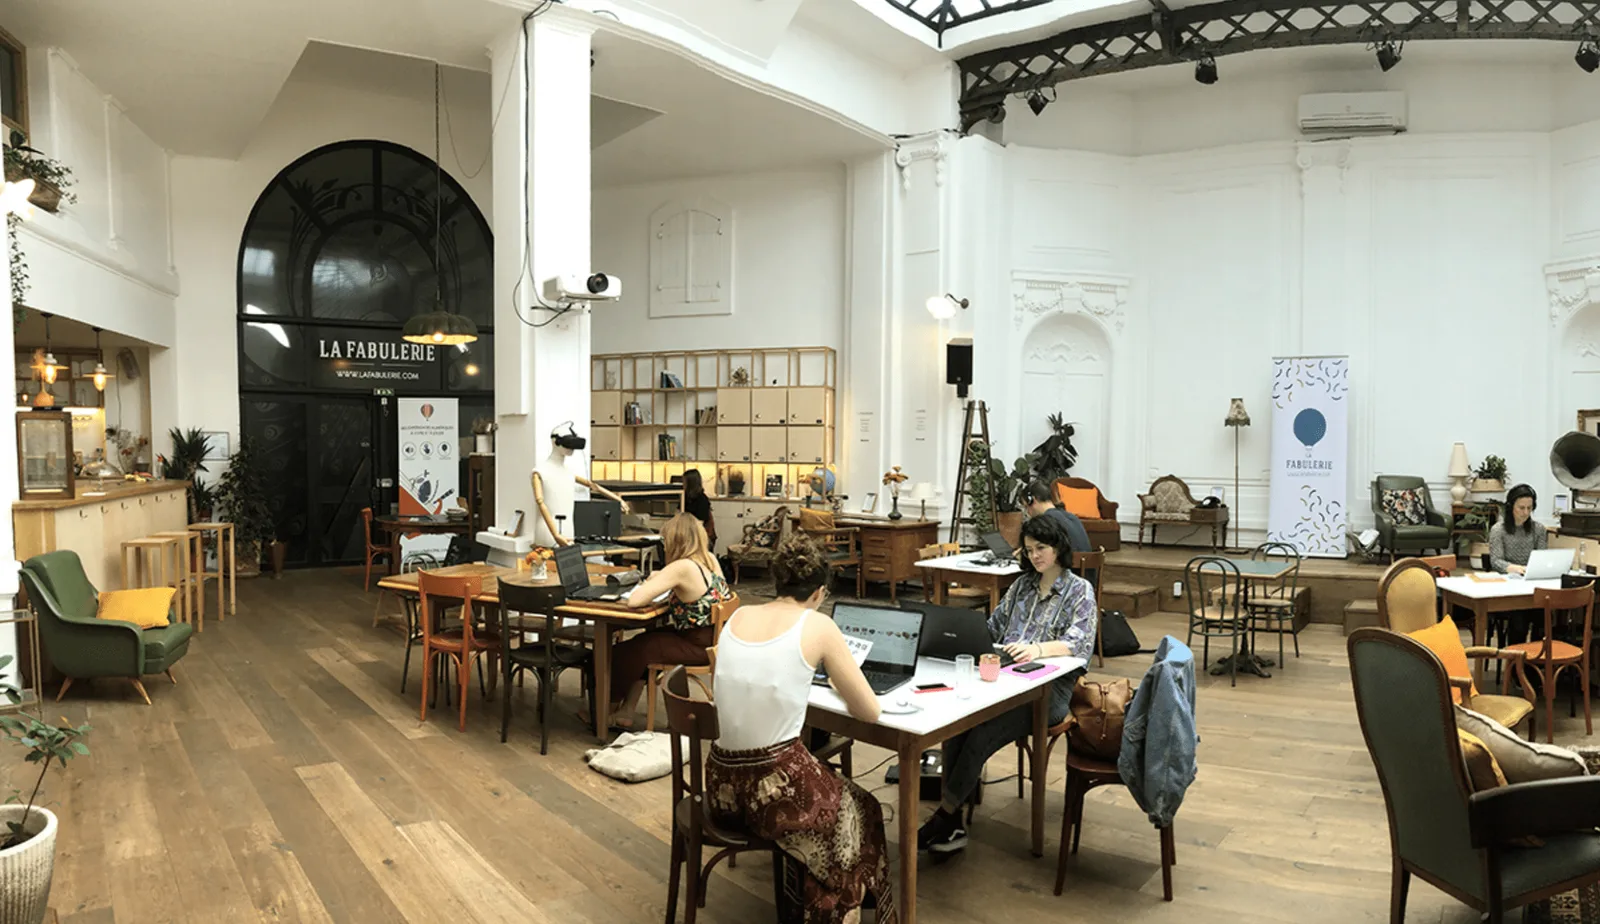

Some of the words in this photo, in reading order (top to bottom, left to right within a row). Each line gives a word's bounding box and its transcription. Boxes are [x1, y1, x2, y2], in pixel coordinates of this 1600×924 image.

[320, 340, 342, 358] LA
[346, 341, 436, 361] FABULERIE
[1286, 459, 1333, 470] FABULERIE
